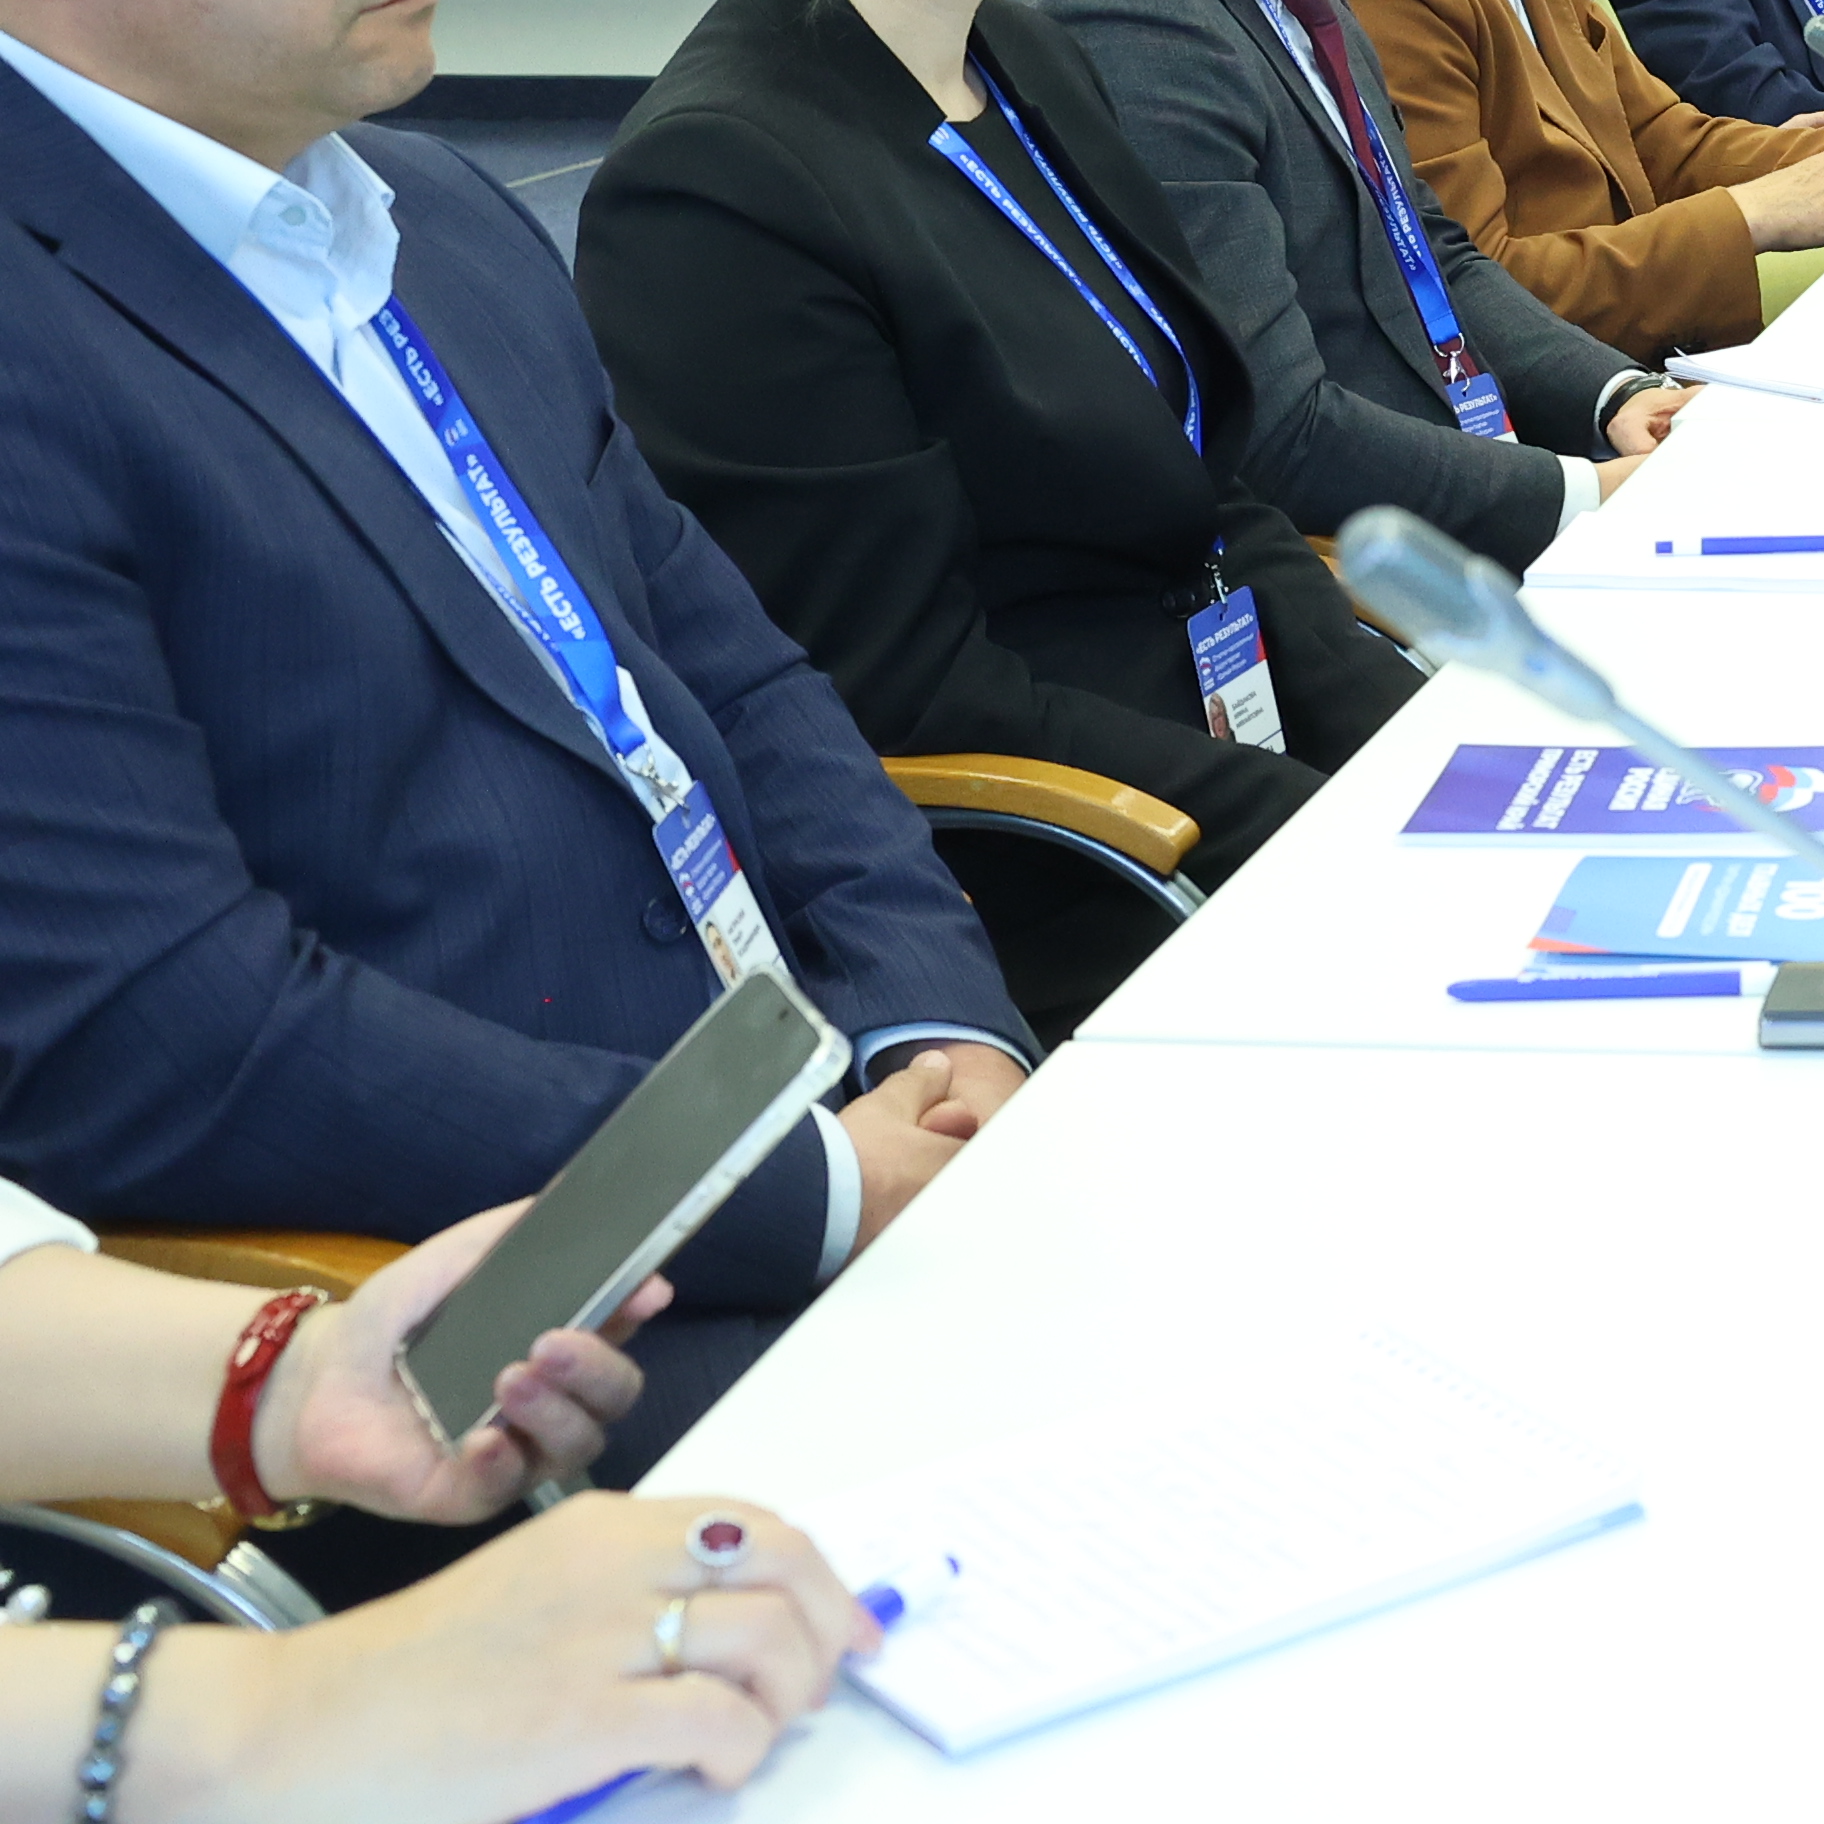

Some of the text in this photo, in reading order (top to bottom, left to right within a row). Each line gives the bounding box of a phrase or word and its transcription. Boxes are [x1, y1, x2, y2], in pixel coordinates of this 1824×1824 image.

[959, 154, 1002, 200] «ЕСТЬ
[466, 454, 547, 579] РЕЗУЛЬТАТ»
[540, 576, 586, 640] «ЕСТЬ
[1608, 767, 1655, 811] РОССИЯ
